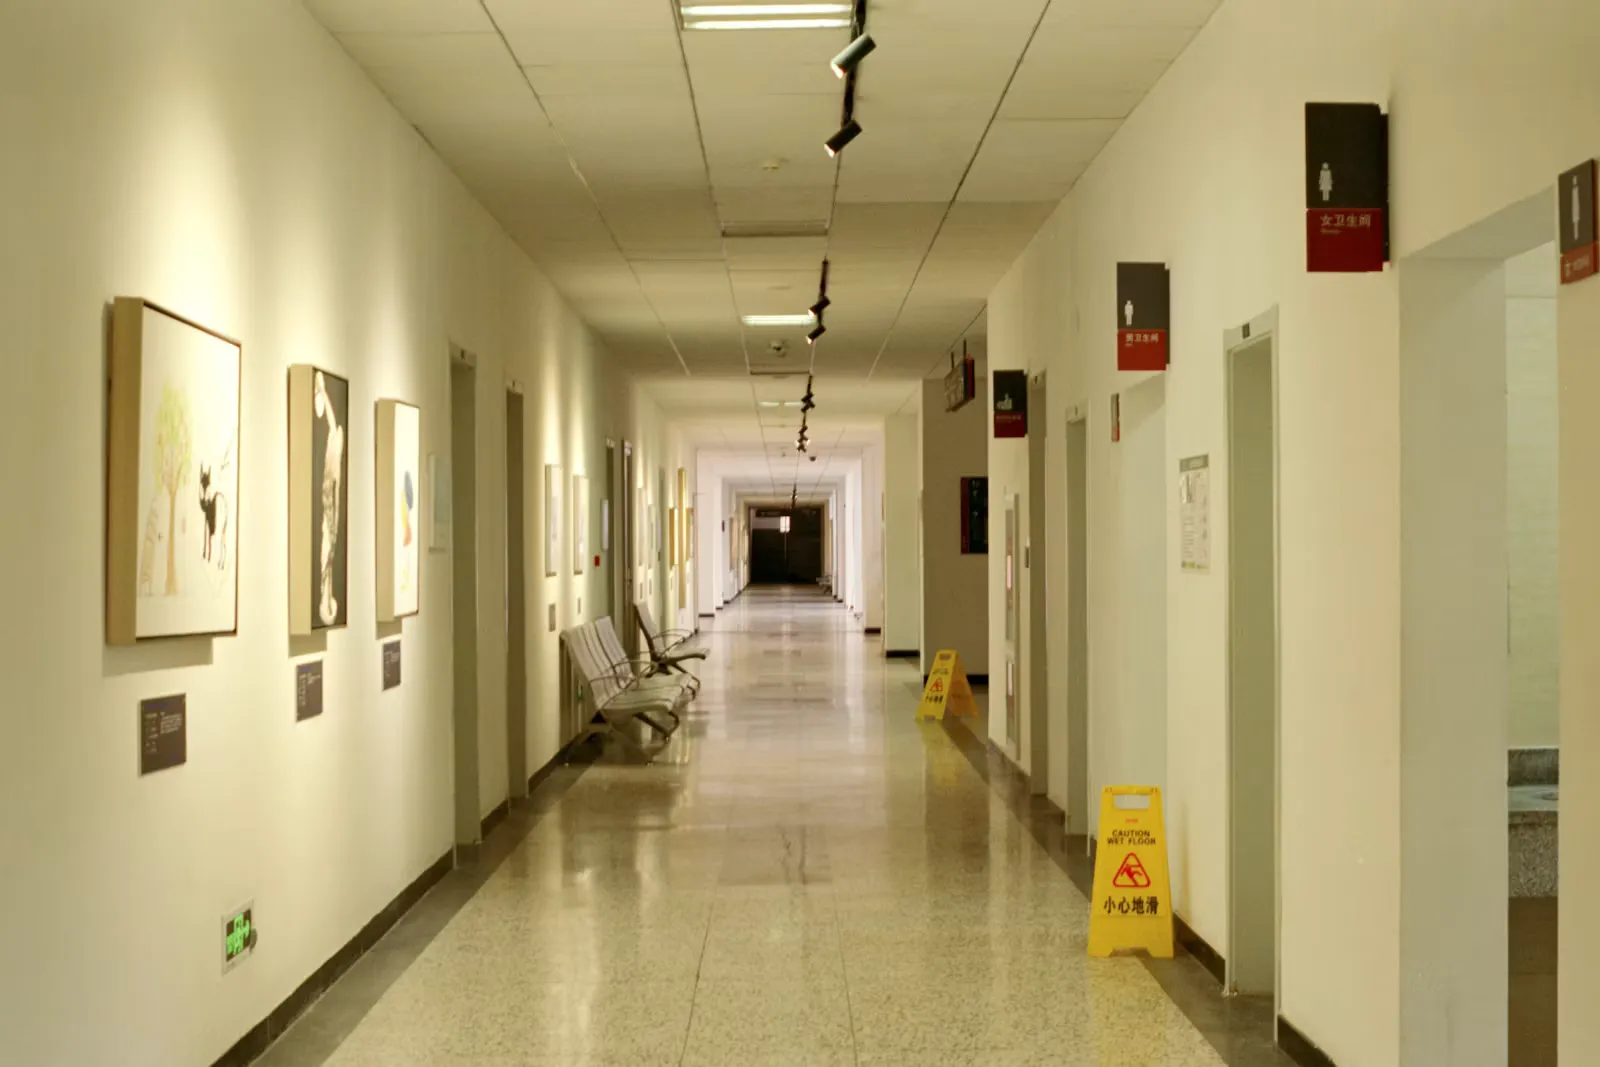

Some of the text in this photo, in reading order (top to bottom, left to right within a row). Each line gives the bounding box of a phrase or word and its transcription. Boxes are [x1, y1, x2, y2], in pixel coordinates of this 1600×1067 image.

[1320, 213, 1372, 228] 女卫生间
[1112, 829, 1151, 837] CAUTION
[1107, 837, 1156, 845] WET FLOOR
[1103, 895, 1160, 915] 小心地滑
